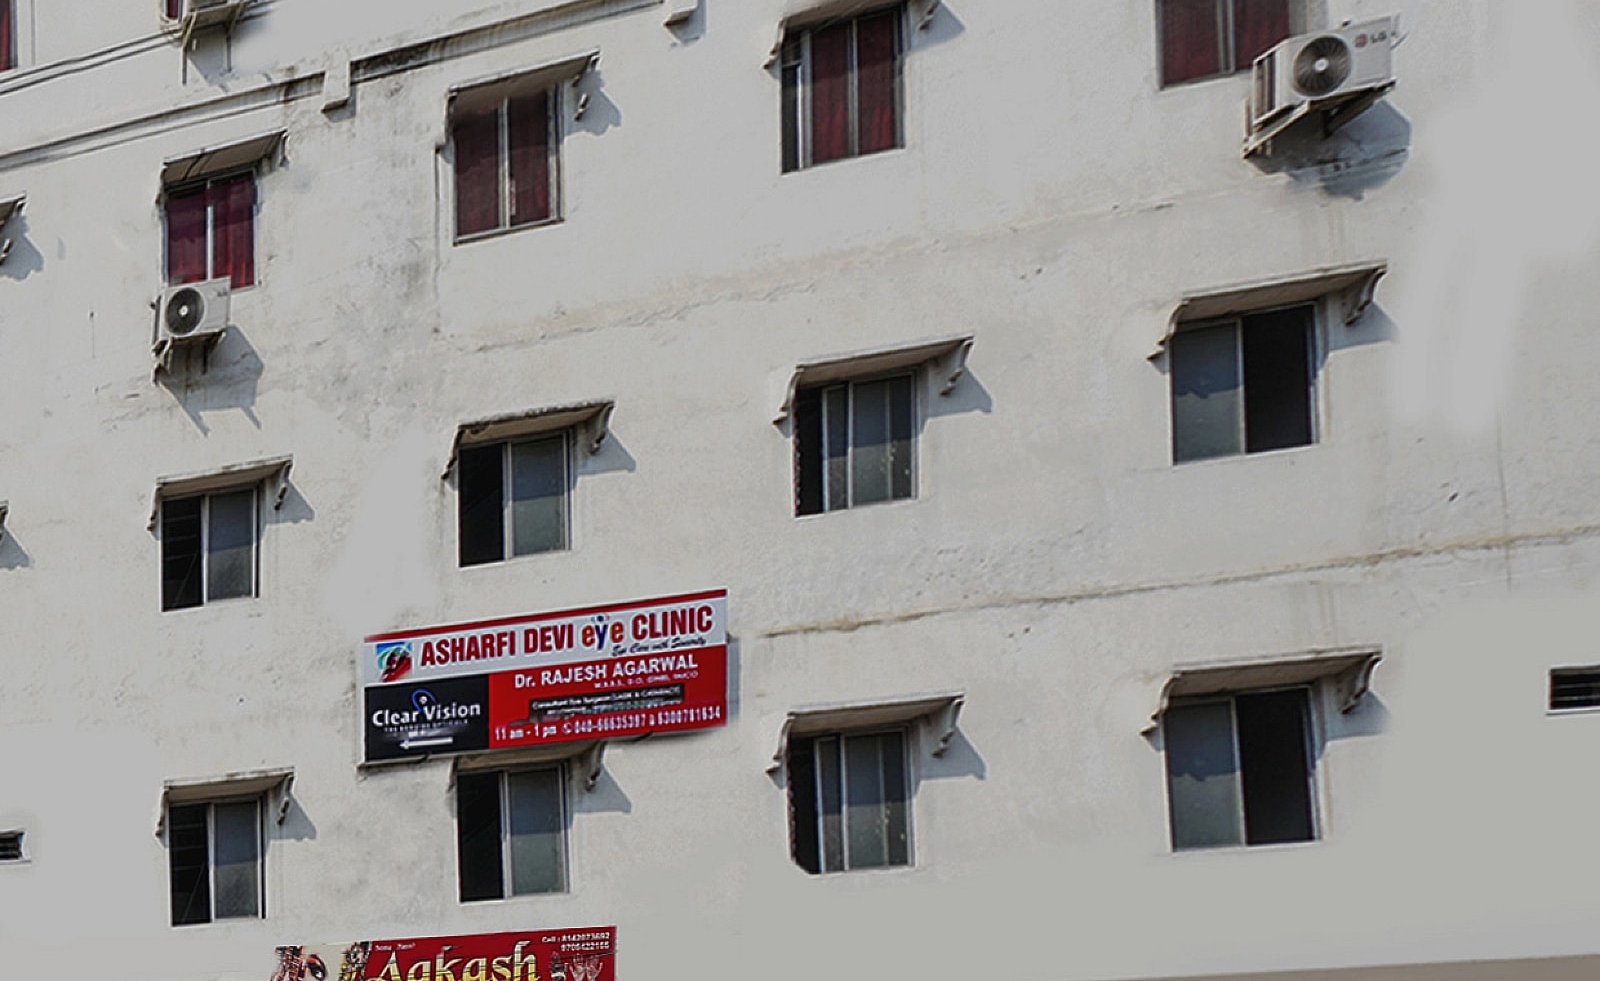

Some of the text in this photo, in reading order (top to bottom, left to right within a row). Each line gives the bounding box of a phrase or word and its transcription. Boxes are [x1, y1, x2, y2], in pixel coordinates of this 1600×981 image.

[420, 605, 713, 667] ASHARFI DEVI eye CLINIC
[514, 654, 698, 688] Dr. RAJESH AGARWAL
[372, 708, 419, 727] Clear
[422, 701, 481, 720] Vision
[369, 939, 541, 981] Aakash
